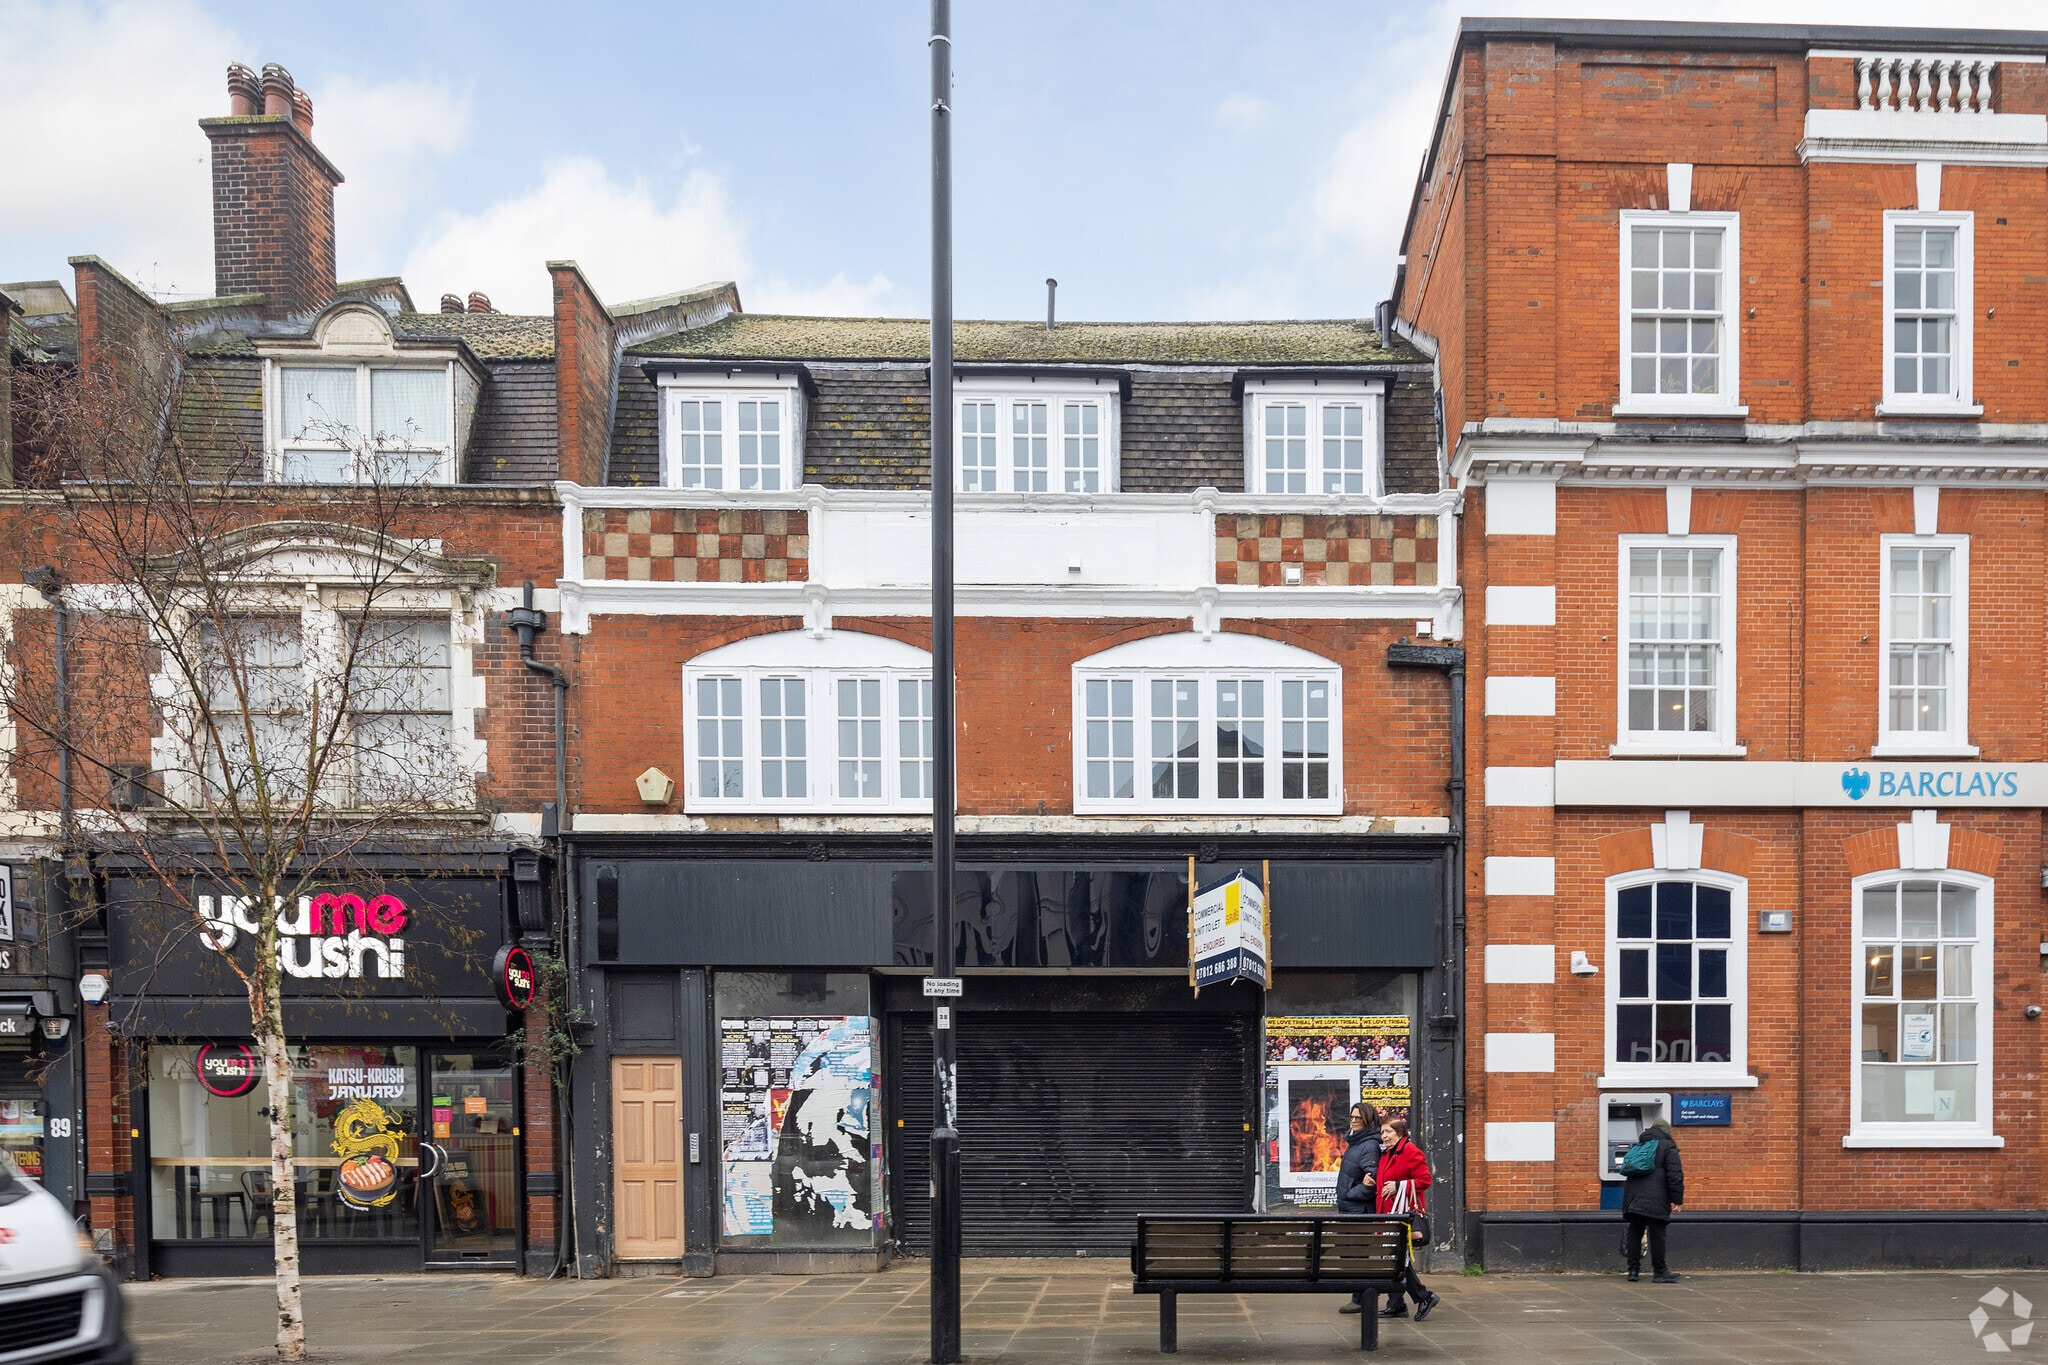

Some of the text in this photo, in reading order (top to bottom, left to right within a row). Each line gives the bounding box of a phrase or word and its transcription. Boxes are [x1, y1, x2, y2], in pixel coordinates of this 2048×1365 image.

[1878, 771, 2018, 797] BARCLAYS
[216, 1064, 246, 1076] sushi
[328, 1067, 404, 1084] KATSU-KRUSH
[328, 1085, 405, 1101] JANUARY
[50, 1118, 71, 1137] 89
